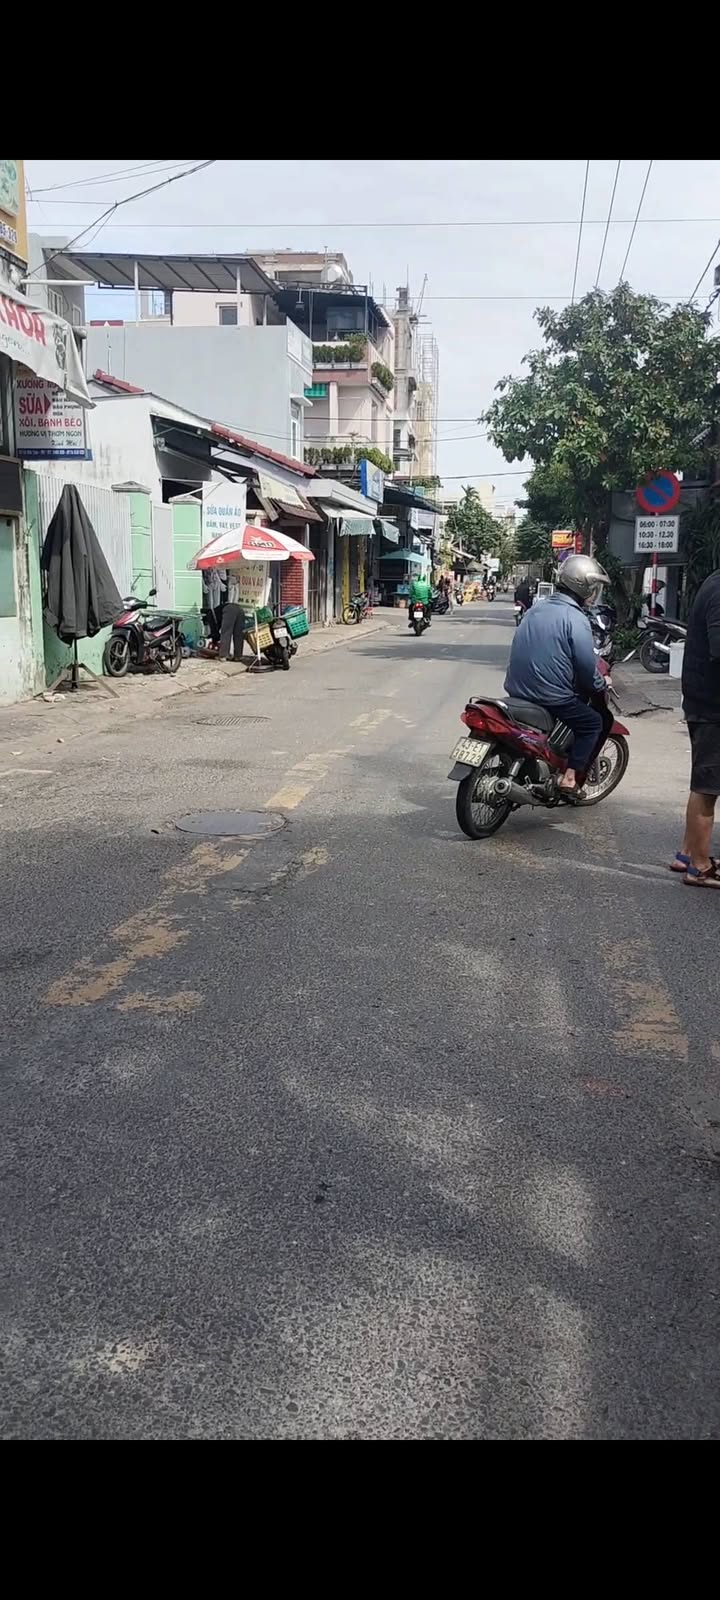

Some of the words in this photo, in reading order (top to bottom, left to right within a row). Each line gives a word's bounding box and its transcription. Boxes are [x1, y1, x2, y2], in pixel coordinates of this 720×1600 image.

[19, 392, 43, 415] SỮA
[639, 520, 655, 528] 06:00
[659, 520, 675, 528] 07:30
[638, 531, 654, 539] 10:30
[461, 739, 484, 753] 43-E1
[452, 748, 482, 765] 387.23
